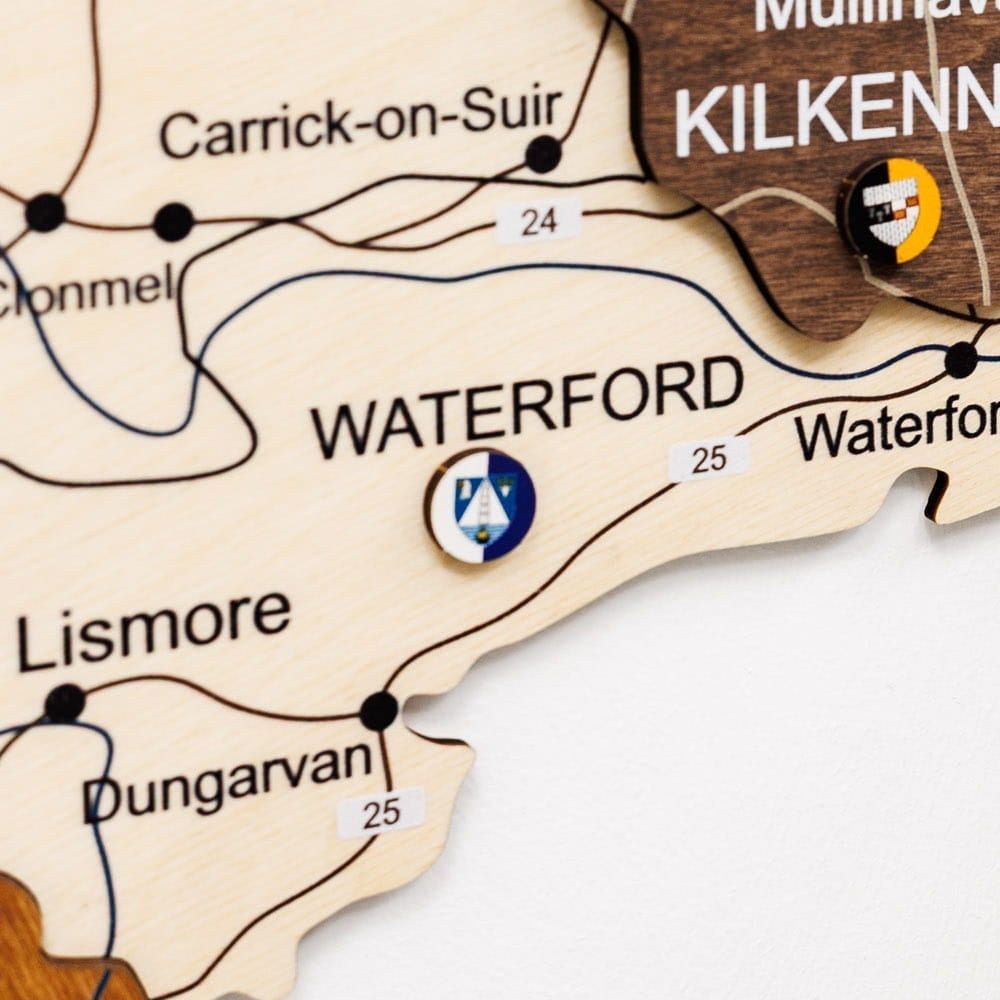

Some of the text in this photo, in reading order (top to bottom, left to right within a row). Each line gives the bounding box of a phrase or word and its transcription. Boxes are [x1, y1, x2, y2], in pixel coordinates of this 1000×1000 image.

[158, 83, 562, 159] Carrick-on-Suir
[520, 208, 557, 236] 24
[310, 354, 744, 460] WATERFORD
[691, 444, 727, 474] 25
[17, 591, 291, 673] Lismore
[82, 742, 373, 825] Dungarvan
[363, 797, 401, 829] 25
